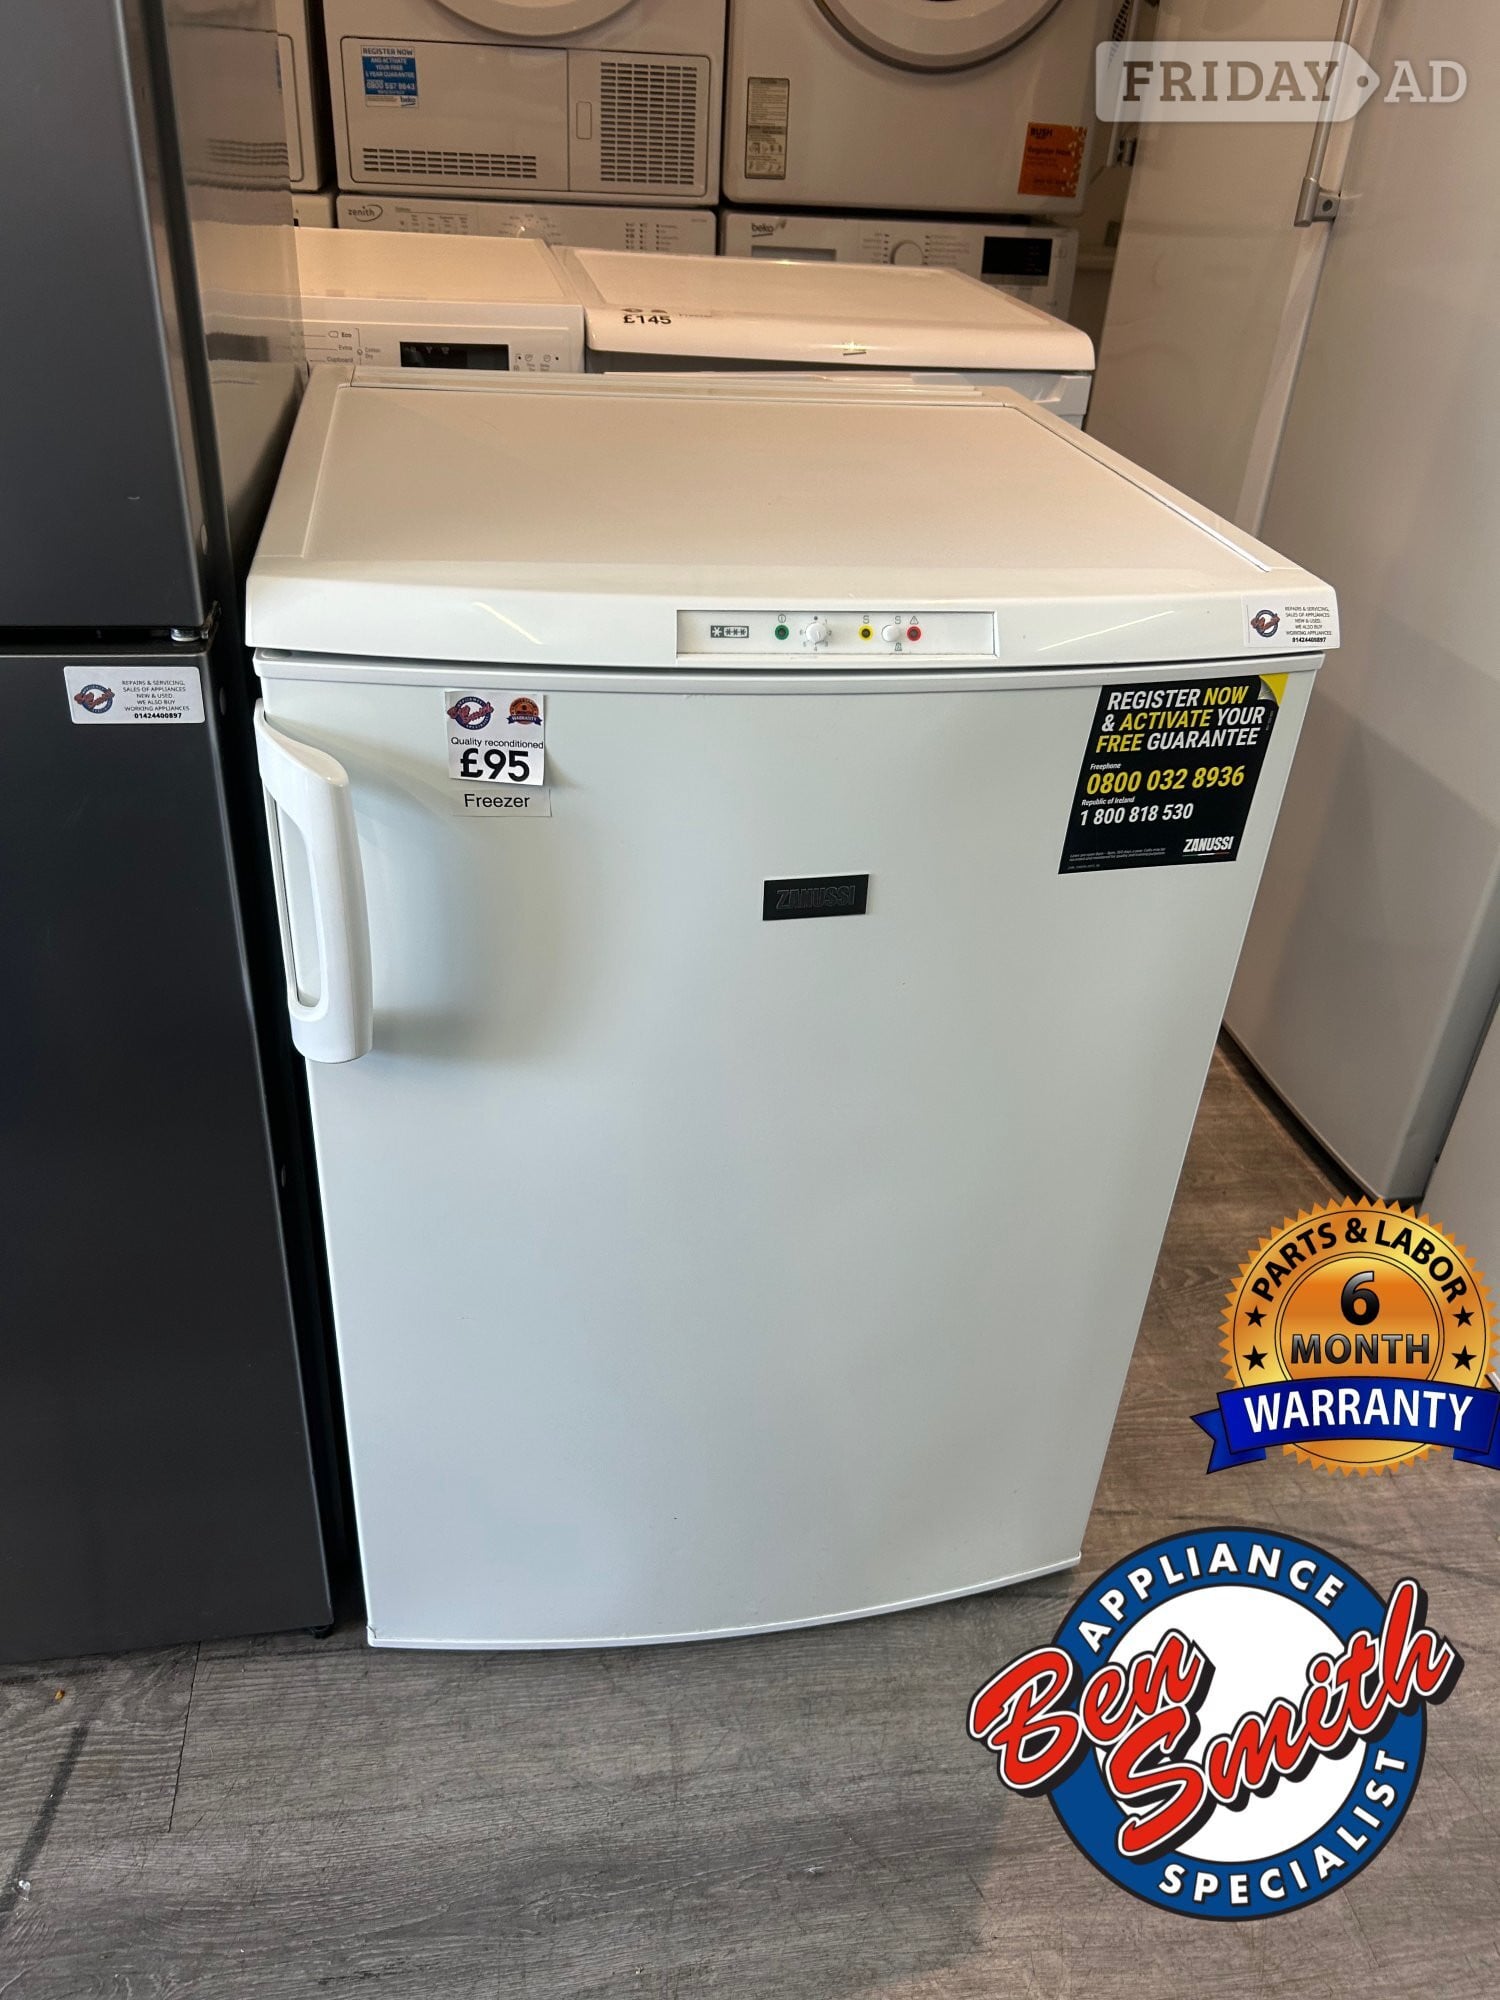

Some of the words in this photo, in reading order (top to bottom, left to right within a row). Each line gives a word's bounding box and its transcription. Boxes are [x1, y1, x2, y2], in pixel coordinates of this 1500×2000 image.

[1030, 127, 1053, 137] BUSH
[348, 206, 375, 217] zenith
[752, 222, 774, 232] beko
[623, 314, 672, 325] £145
[863, 615, 870, 624] S
[895, 616, 901, 625] S
[1106, 688, 1201, 711] REGISTER
[1203, 686, 1249, 706] NOW
[1101, 713, 1115, 732] &
[1118, 709, 1214, 731] ACTIVATE
[1216, 706, 1266, 727] YOUR
[451, 737, 482, 747] Quality
[484, 739, 544, 749] reconditioned
[1095, 733, 1145, 754] FREE
[1146, 727, 1261, 751] GUARANTEE
[460, 748, 530, 782] £95
[1090, 762, 1122, 771] Freephone
[1086, 771, 1142, 795] 0800
[1146, 768, 1189, 791] 032
[1191, 765, 1245, 789] 8936
[464, 793, 531, 808] Freezer
[1081, 797, 1106, 807] Republic
[1114, 796, 1135, 805] Ireland
[1080, 811, 1088, 826] 1
[1093, 807, 1126, 825] 800
[1128, 805, 1159, 823] 818
[1161, 803, 1194, 820] 530
[1183, 836, 1235, 853] ZANUSSI
[775, 885, 856, 910] ZANUSSI
